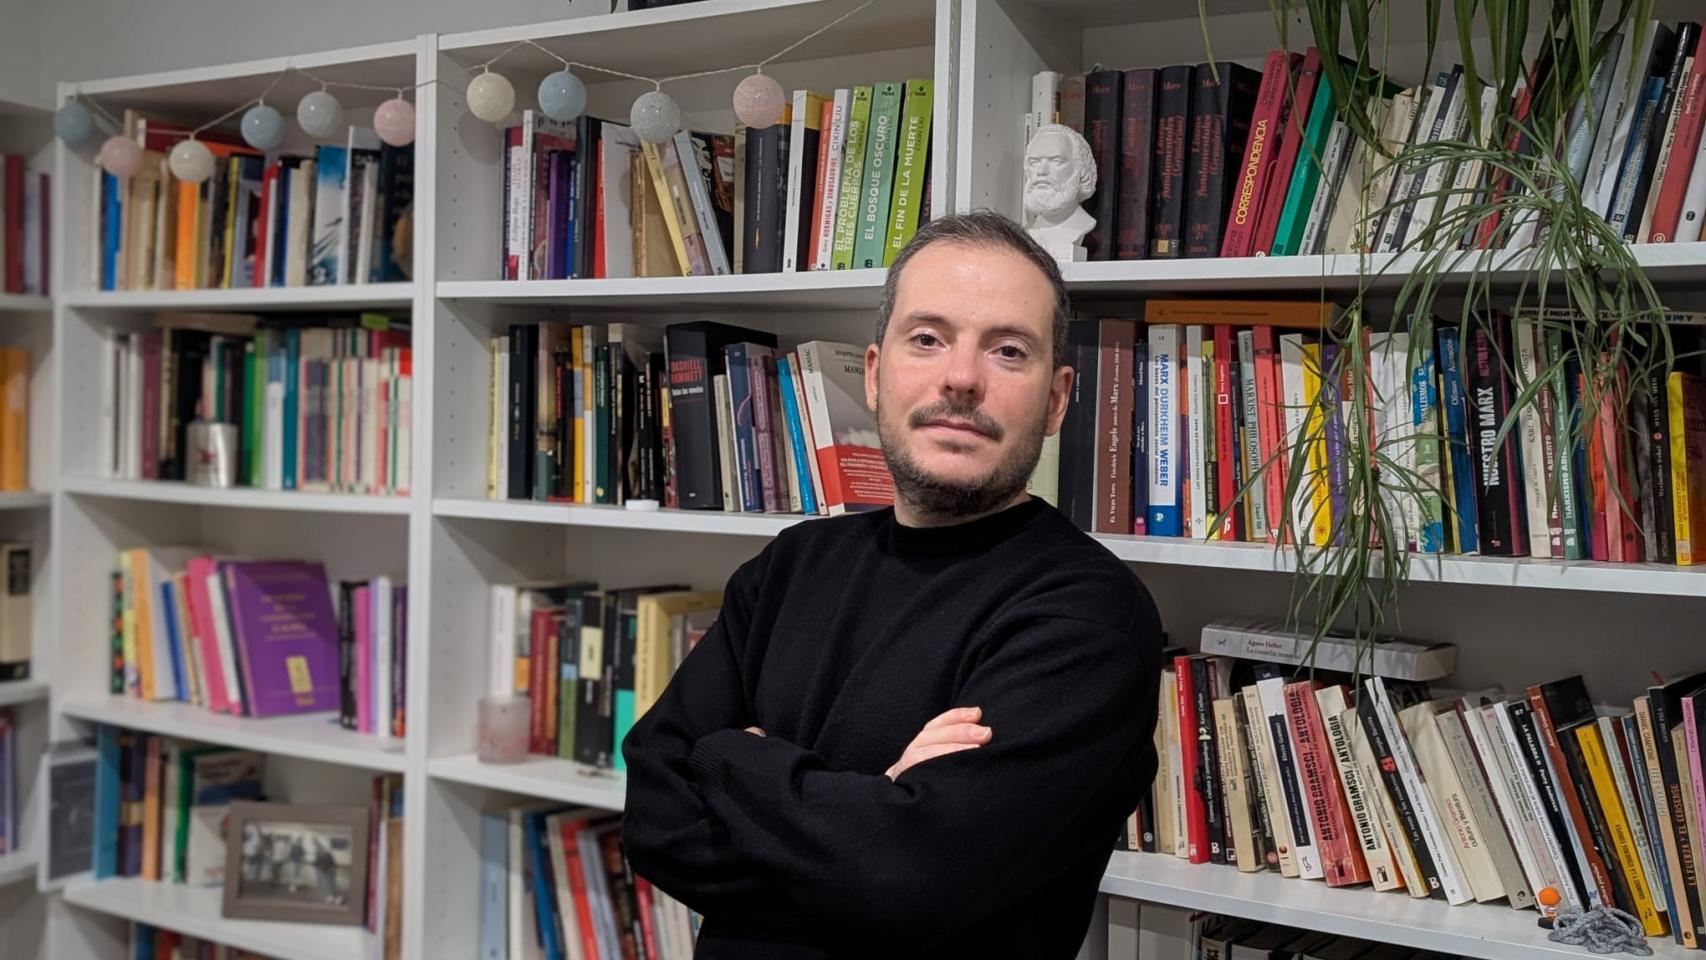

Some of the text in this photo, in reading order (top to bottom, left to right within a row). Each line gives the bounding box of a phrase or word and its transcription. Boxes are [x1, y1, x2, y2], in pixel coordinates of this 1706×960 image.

[832, 124, 840, 151] CIXIN
[835, 119, 859, 251] EL PROBLEMA DE LOS
[864, 114, 888, 240] EL BOSQUE OSCURO
[892, 114, 918, 249] EL FIN DE LA MUERTE
[1236, 117, 1269, 226] CORRESPONDENCIA
[823, 156, 837, 237] HORMIGAS DINOSAURIOS
[844, 160, 861, 252] TRES CUERPOS
[844, 364, 865, 374] MANI
[1445, 338, 1458, 405] Ollman Alienación
[1110, 383, 1119, 403] Marx
[1244, 378, 1256, 417] MARXIST
[1478, 386, 1496, 426] MARX
[1109, 427, 1119, 452] Engels
[1159, 354, 1168, 487] MARX DURKHEIM WEBER
[1527, 424, 1536, 443] KARL
[1481, 429, 1500, 486] NUESTRO
[1544, 435, 1553, 469] ABIERTO
[1561, 472, 1573, 518] MARXISMO
[1637, 710, 1649, 732] DANIEL
[1507, 741, 1523, 768] occidental
[1642, 731, 1655, 761] CAMPIONE
[1250, 760, 1264, 796] Democracia
[1288, 690, 1334, 842] ANTONIO GRAMSCI ANTOLOGIA
[1328, 714, 1376, 852] ANTONIO GRAMSCI ANTOLOGIA
[1518, 768, 1533, 795] marxismo
[1525, 732, 1540, 760] PALABRA
[1538, 768, 1550, 785] Perry
[1545, 784, 1561, 813] Anderson
[1442, 798, 1470, 851] Antonio Gramsci
[1530, 801, 1542, 817] sobre
[1677, 823, 1687, 833] EL
[1462, 826, 1478, 849] cultura
[1537, 816, 1559, 860] Consideraciones
[1681, 842, 1695, 873] FUERZA
[1687, 874, 1697, 886] LA
